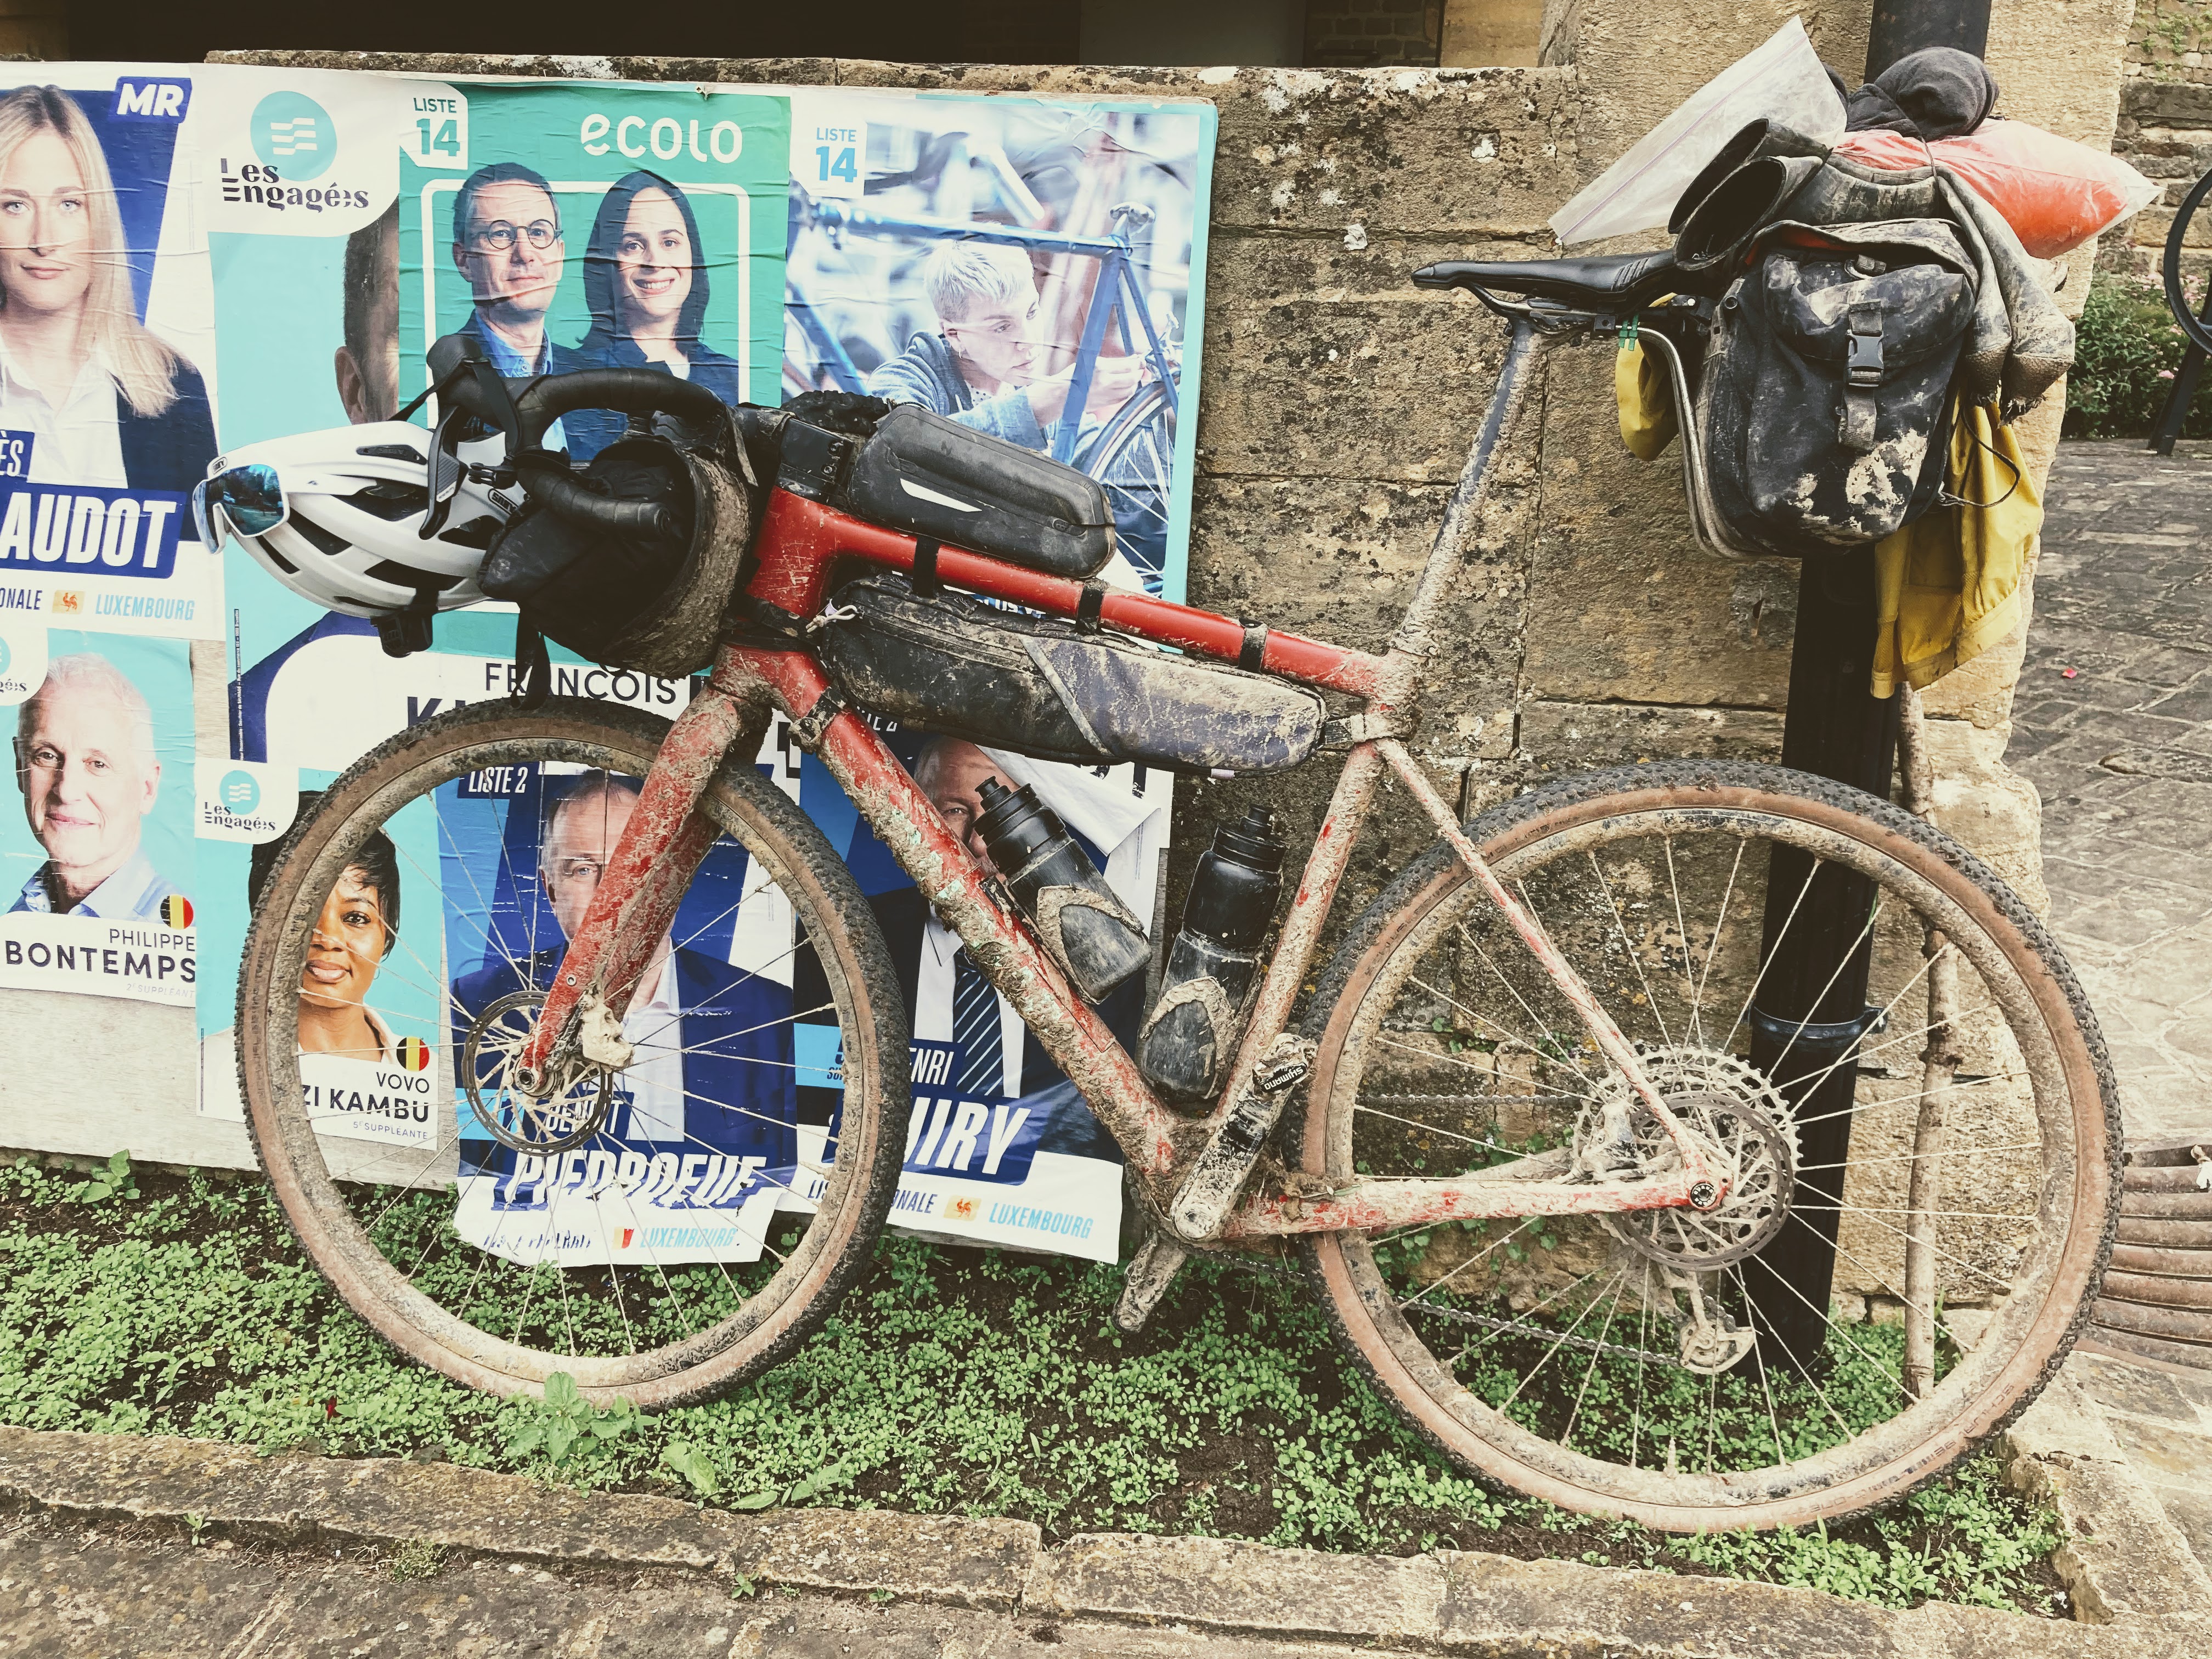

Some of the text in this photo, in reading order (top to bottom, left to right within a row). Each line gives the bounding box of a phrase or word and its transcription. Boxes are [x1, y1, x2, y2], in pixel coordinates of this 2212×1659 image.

[116, 83, 184, 117] MR
[413, 97, 456, 114] LISTE
[416, 118, 460, 156] 14
[580, 114, 743, 163] ecolo
[816, 127, 856, 143] LISTE
[220, 158, 279, 183] Les
[816, 145, 857, 183] 14
[95, 593, 195, 621] LUXEMBOURG
[468, 766, 528, 793] LISTE 2
[205, 802, 231, 816] Les
[110, 928, 195, 952] PHILIPPE
[5, 940, 195, 983] BONTEMPS
[376, 1071, 430, 1093] VOVO
[1264, 1066, 1304, 1090] SHIMANO
[301, 1084, 429, 1122] ZI KAMBU
[364, 1122, 428, 1139] SUPPLÉANTE
[989, 1203, 1093, 1239] LUXEMBOURG
[640, 1227, 738, 1248] LUXEMBOURG
